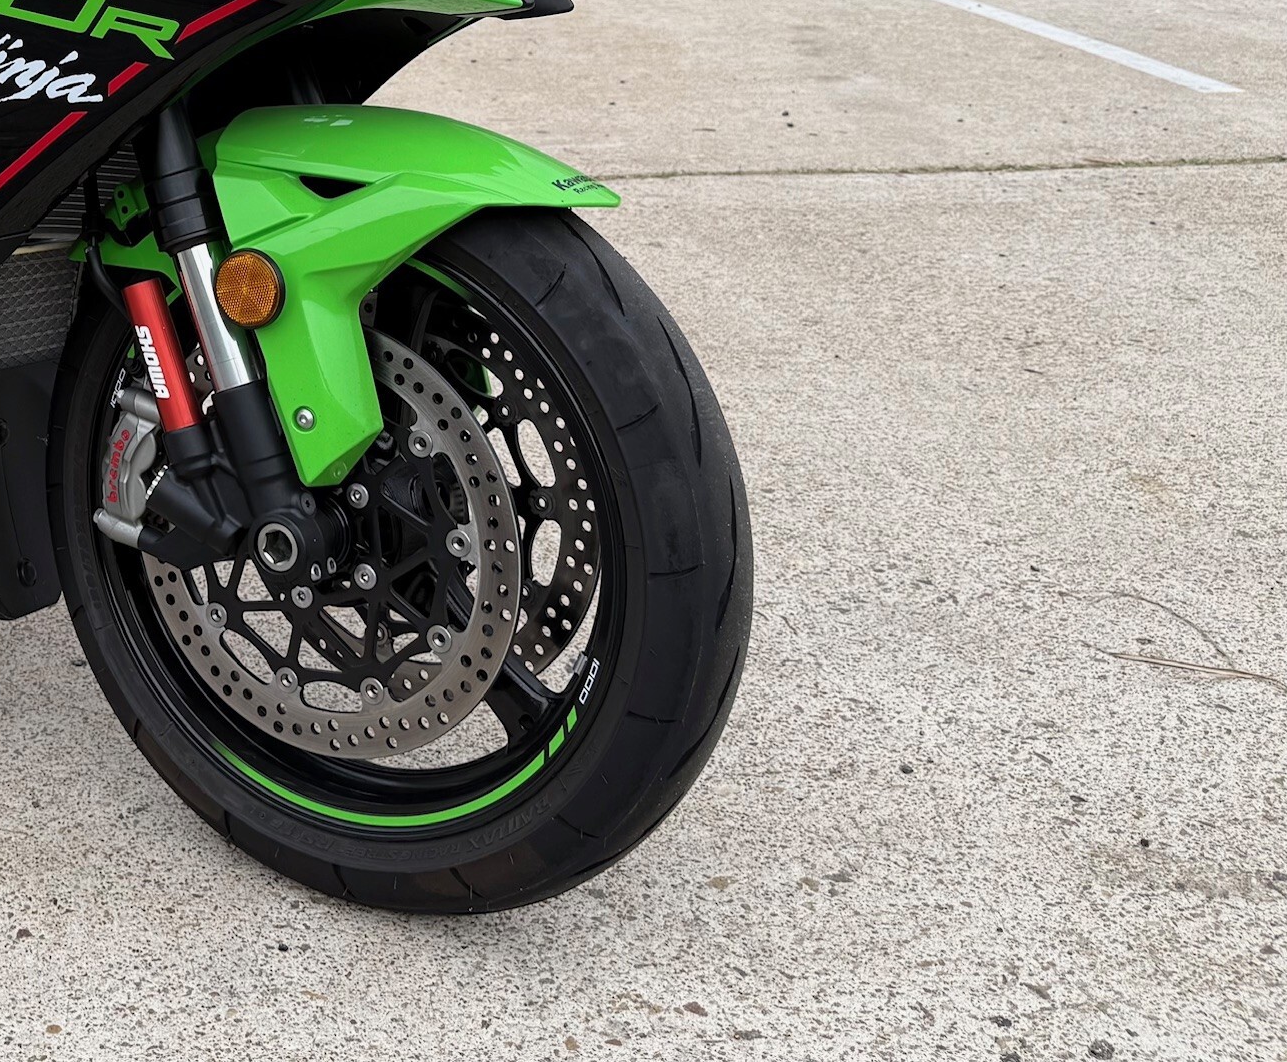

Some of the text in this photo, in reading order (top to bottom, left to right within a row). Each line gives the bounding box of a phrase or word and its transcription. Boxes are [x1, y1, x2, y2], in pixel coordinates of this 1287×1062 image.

[134, 325, 170, 399] SHOWA
[107, 429, 131, 503] brembo
[579, 657, 600, 705] 1000
